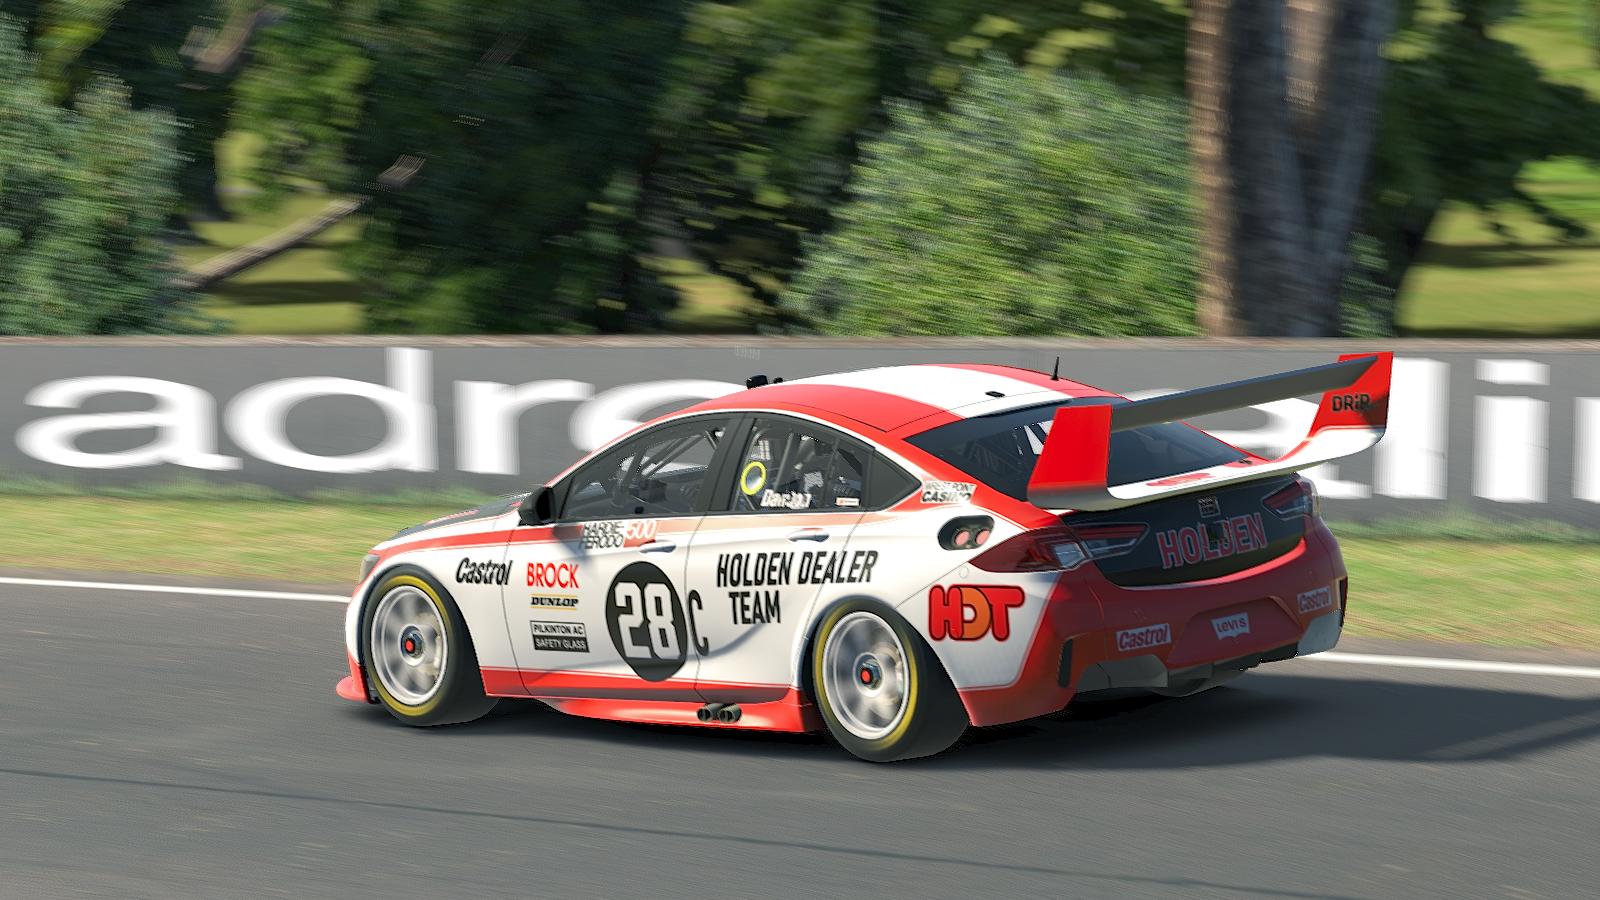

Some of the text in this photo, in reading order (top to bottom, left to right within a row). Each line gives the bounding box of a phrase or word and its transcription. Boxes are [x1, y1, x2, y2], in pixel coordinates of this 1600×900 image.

[583, 534, 624, 549] FERODO
[626, 519, 657, 539] 500
[1156, 512, 1268, 569] HOLDEN
[456, 557, 513, 585] Castrol
[527, 562, 580, 589] BROCK
[717, 550, 879, 588] HOLDEN DEALER
[531, 597, 579, 607] DUNLOP
[728, 590, 781, 624] TEAM
[928, 584, 1026, 641] HDT
[573, 625, 583, 635] AC
[614, 582, 710, 660] 28 C
[536, 639, 586, 649] SAFETY GLASS
[1119, 625, 1168, 650] Castrol
